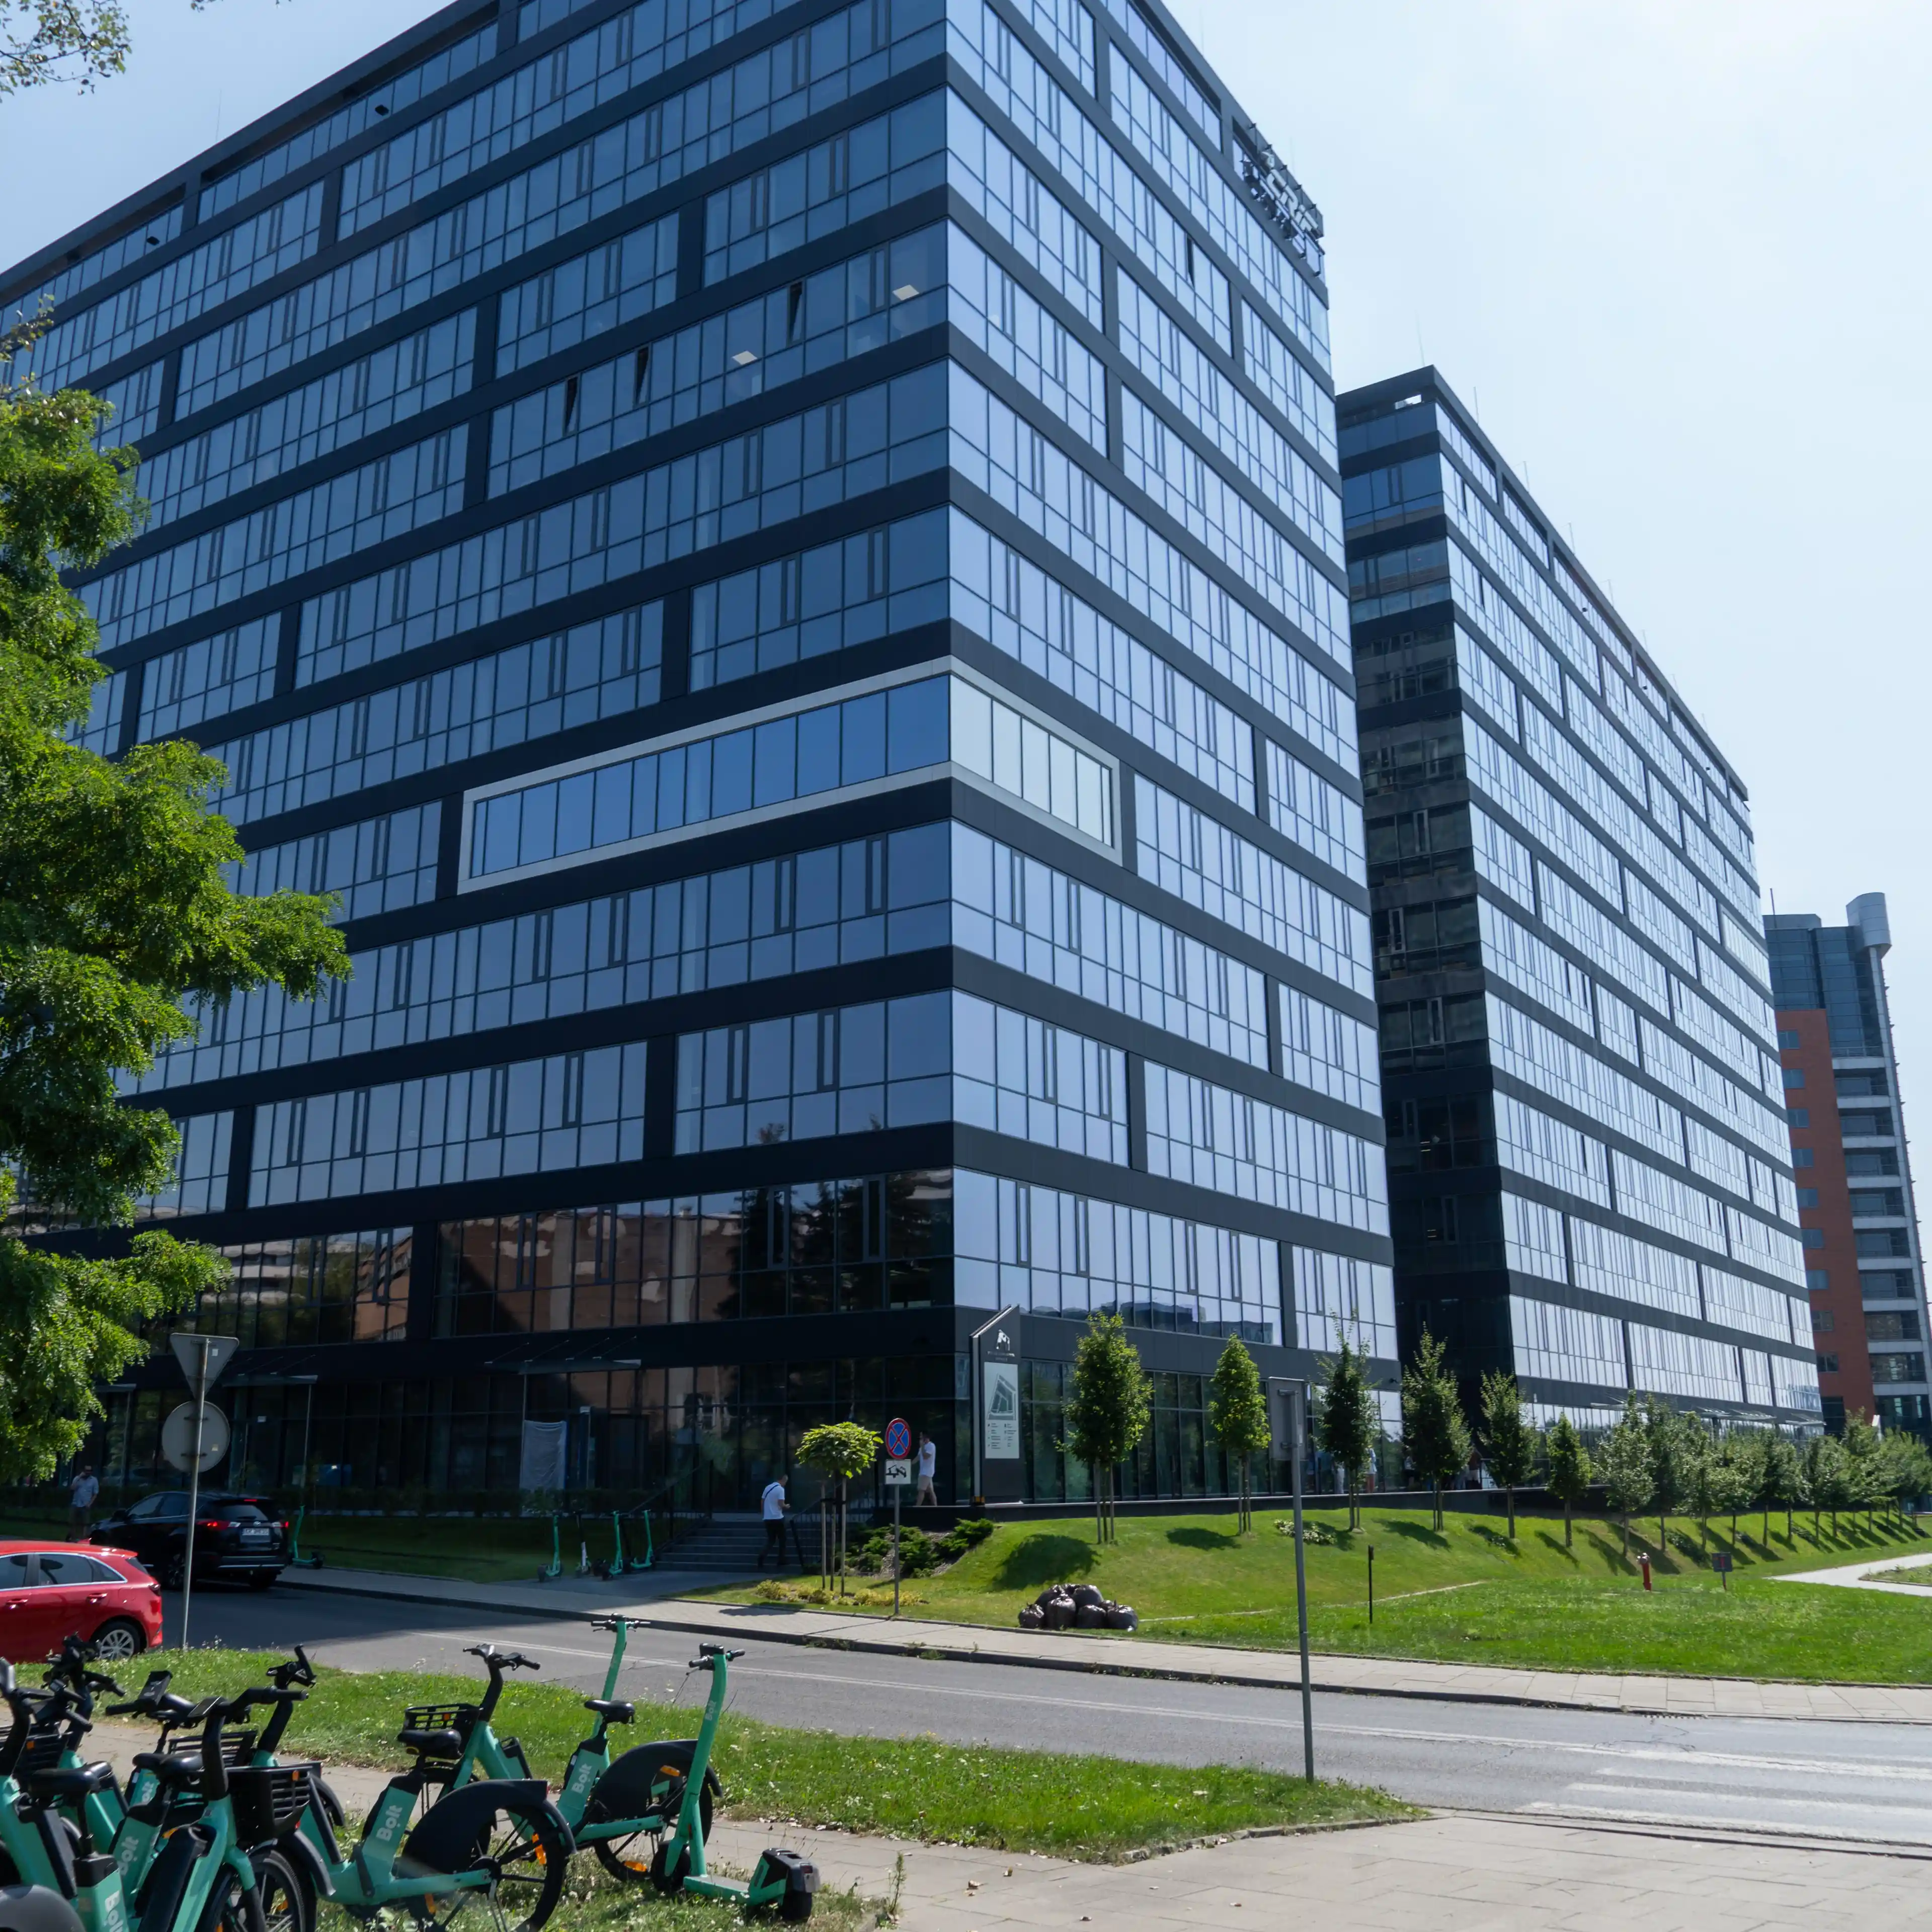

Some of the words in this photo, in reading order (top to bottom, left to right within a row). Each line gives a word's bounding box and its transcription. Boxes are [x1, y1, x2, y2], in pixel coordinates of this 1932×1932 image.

[142, 1782, 154, 1802] olt
[572, 1763, 592, 1794] Bolt
[376, 1805, 403, 1842] Bolt
